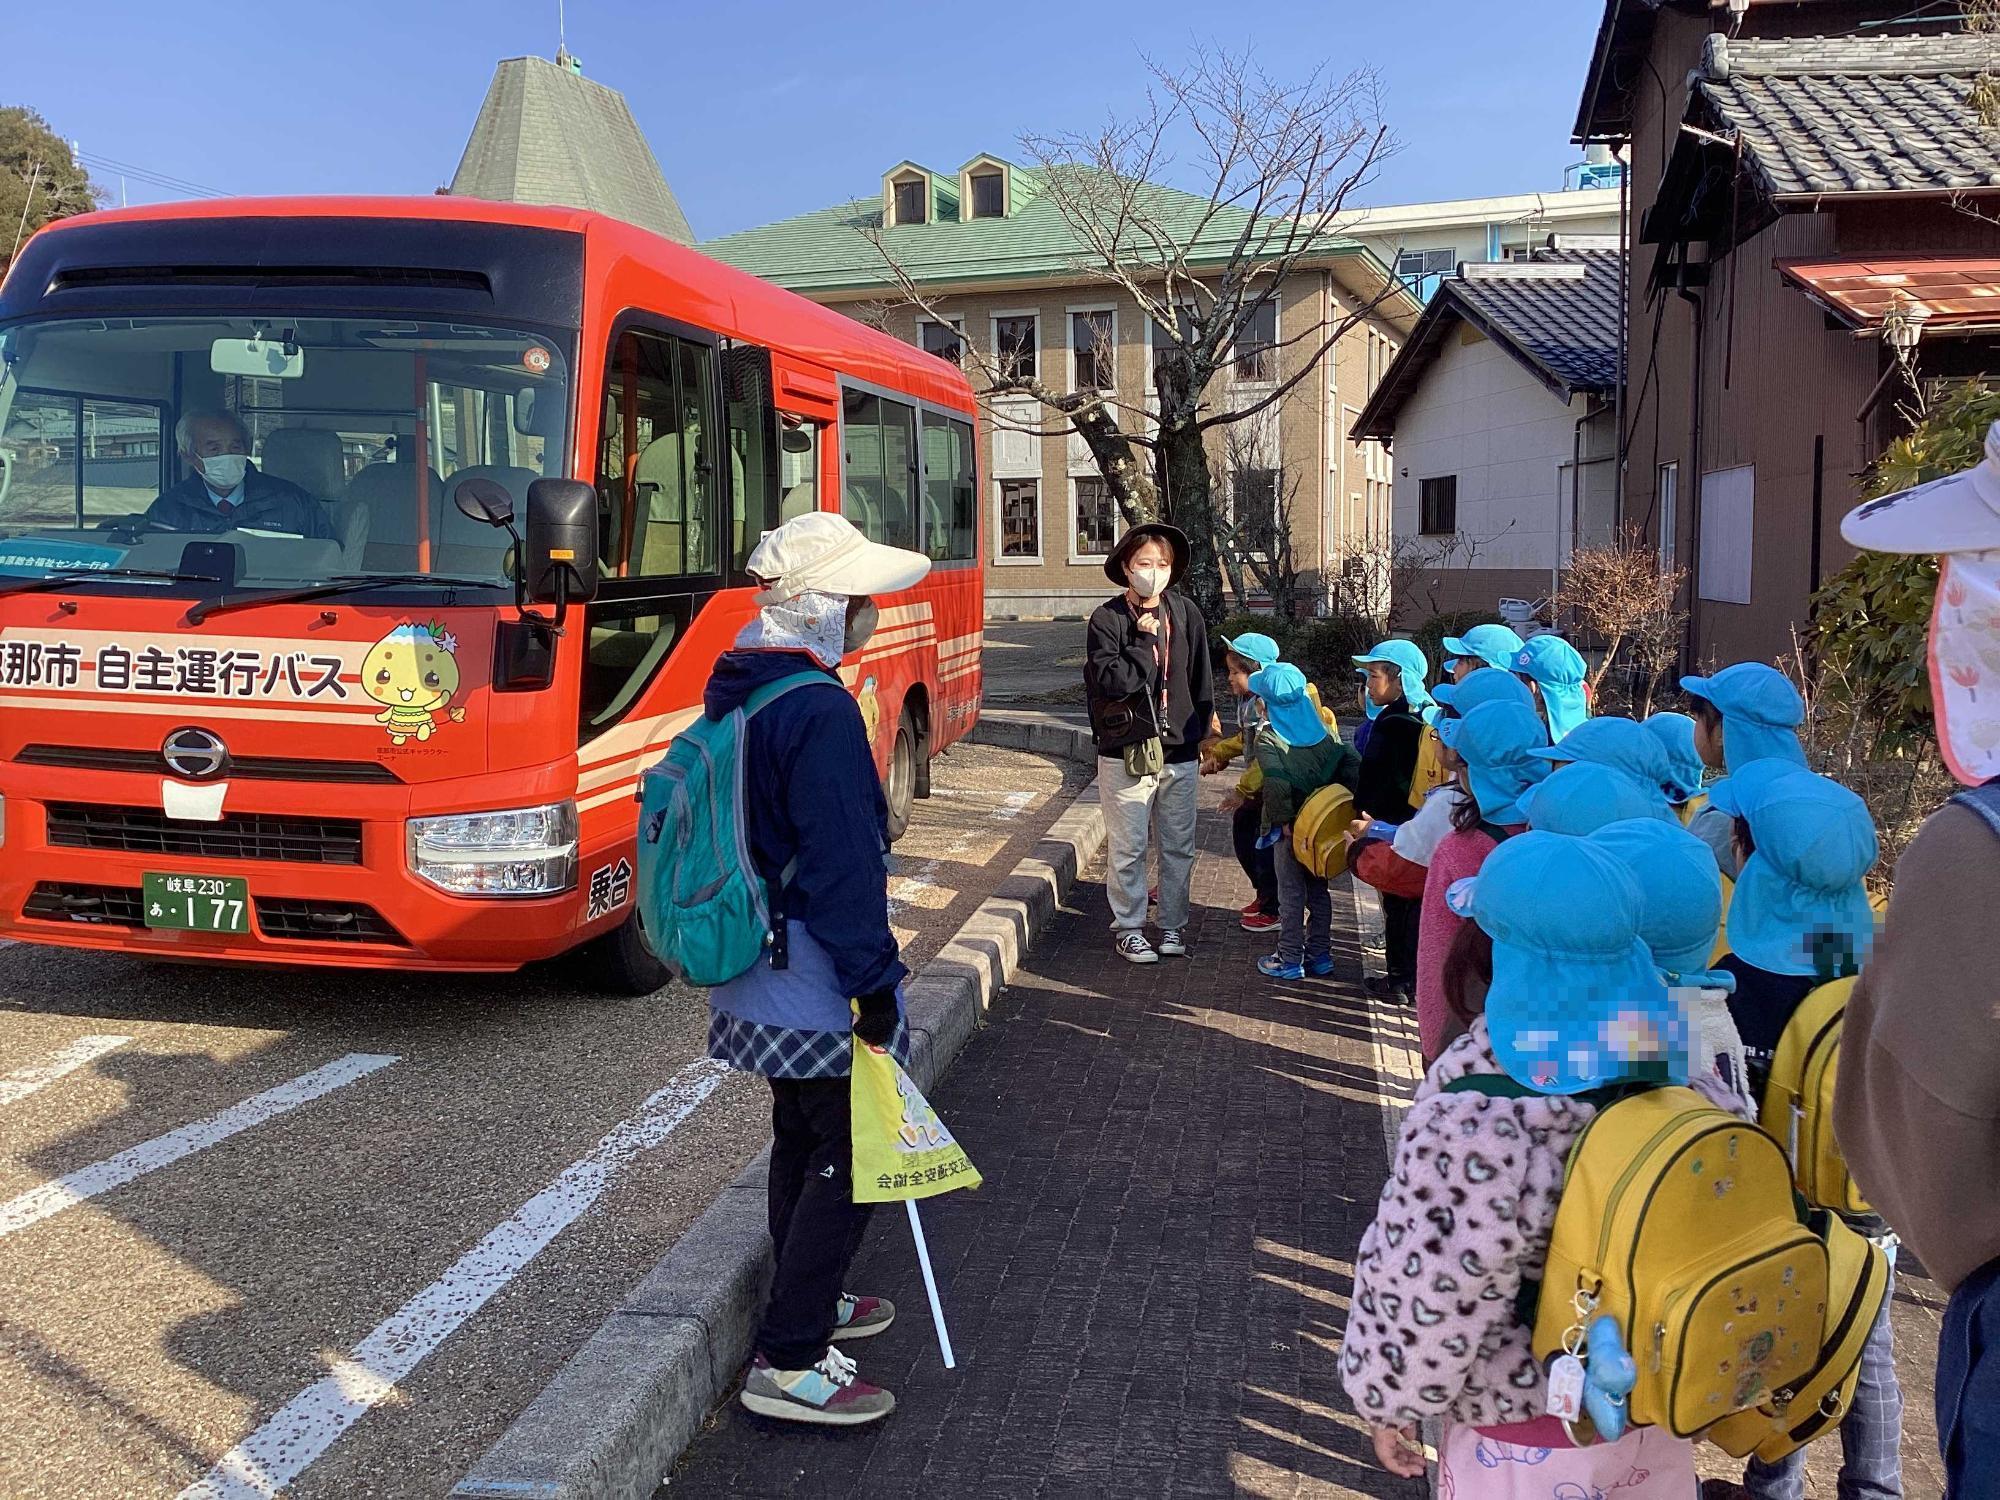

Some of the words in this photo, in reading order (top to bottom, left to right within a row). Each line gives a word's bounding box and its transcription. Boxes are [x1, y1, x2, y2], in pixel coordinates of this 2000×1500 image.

[0, 643, 81, 687] 那市
[99, 645, 347, 698] 自主運行バス
[167, 877, 225, 896] 岐阜230
[588, 858, 632, 920] 乗合
